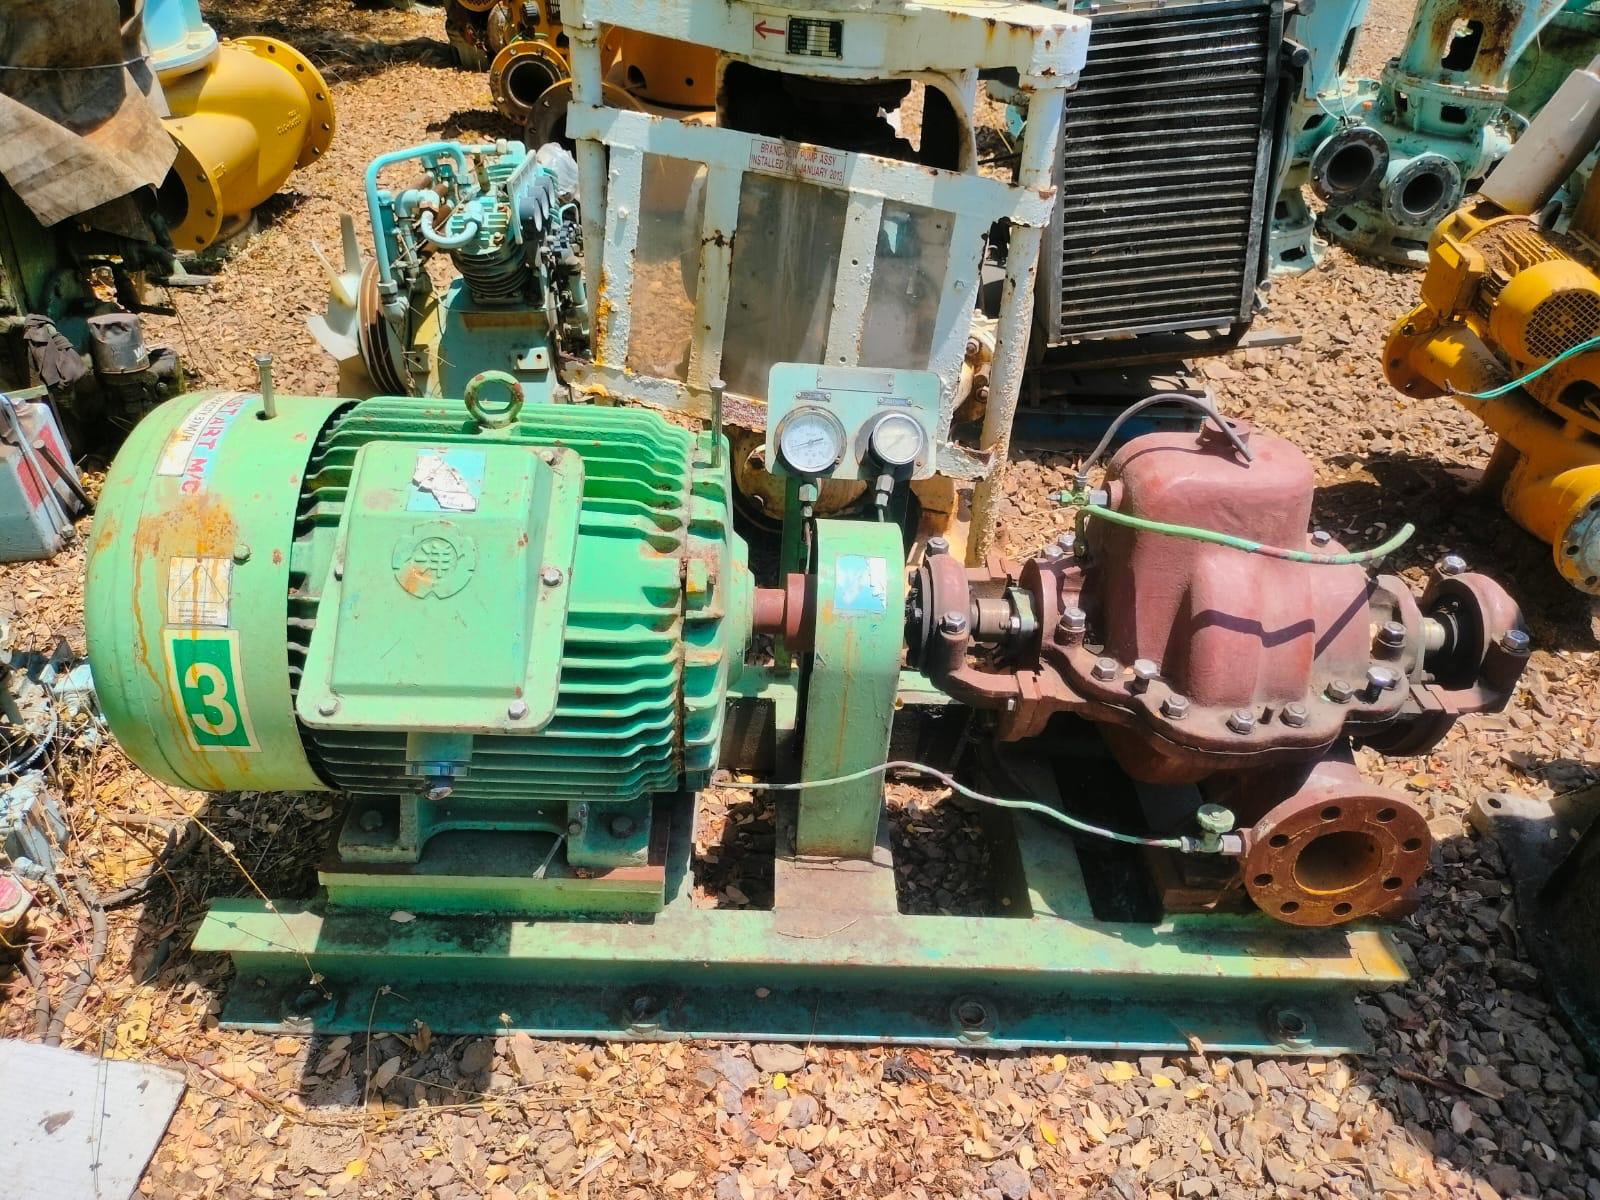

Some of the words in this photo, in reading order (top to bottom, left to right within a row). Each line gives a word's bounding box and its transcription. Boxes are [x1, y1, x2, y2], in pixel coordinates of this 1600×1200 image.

[751, 154, 784, 169] INSTALLED
[799, 163, 827, 177] JANUARY
[820, 154, 837, 166] ASSY
[181, 458, 208, 494] M/C
[184, 662, 237, 736] 3
